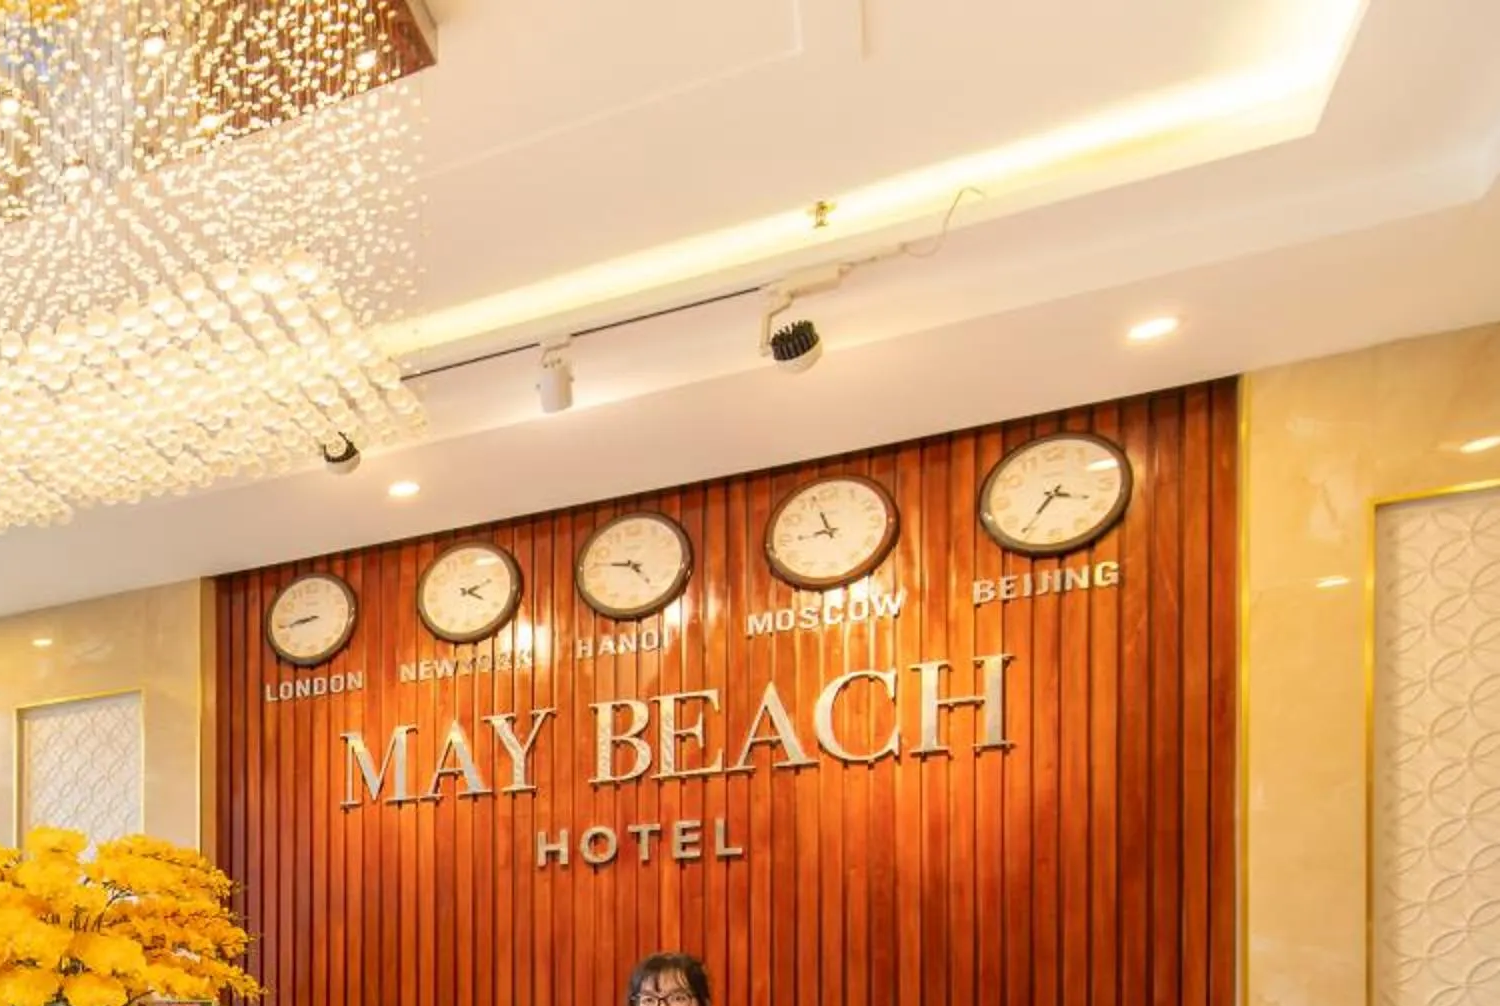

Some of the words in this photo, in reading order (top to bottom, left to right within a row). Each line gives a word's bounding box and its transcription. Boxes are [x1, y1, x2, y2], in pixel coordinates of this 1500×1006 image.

[973, 560, 1120, 606] BEIJING
[746, 587, 907, 637] MOSCOW
[575, 627, 670, 659] HANOI
[264, 671, 365, 703] LONDON
[339, 706, 557, 811] MAY
[587, 652, 1016, 787] BEACH
[536, 817, 744, 869] HOTEL
